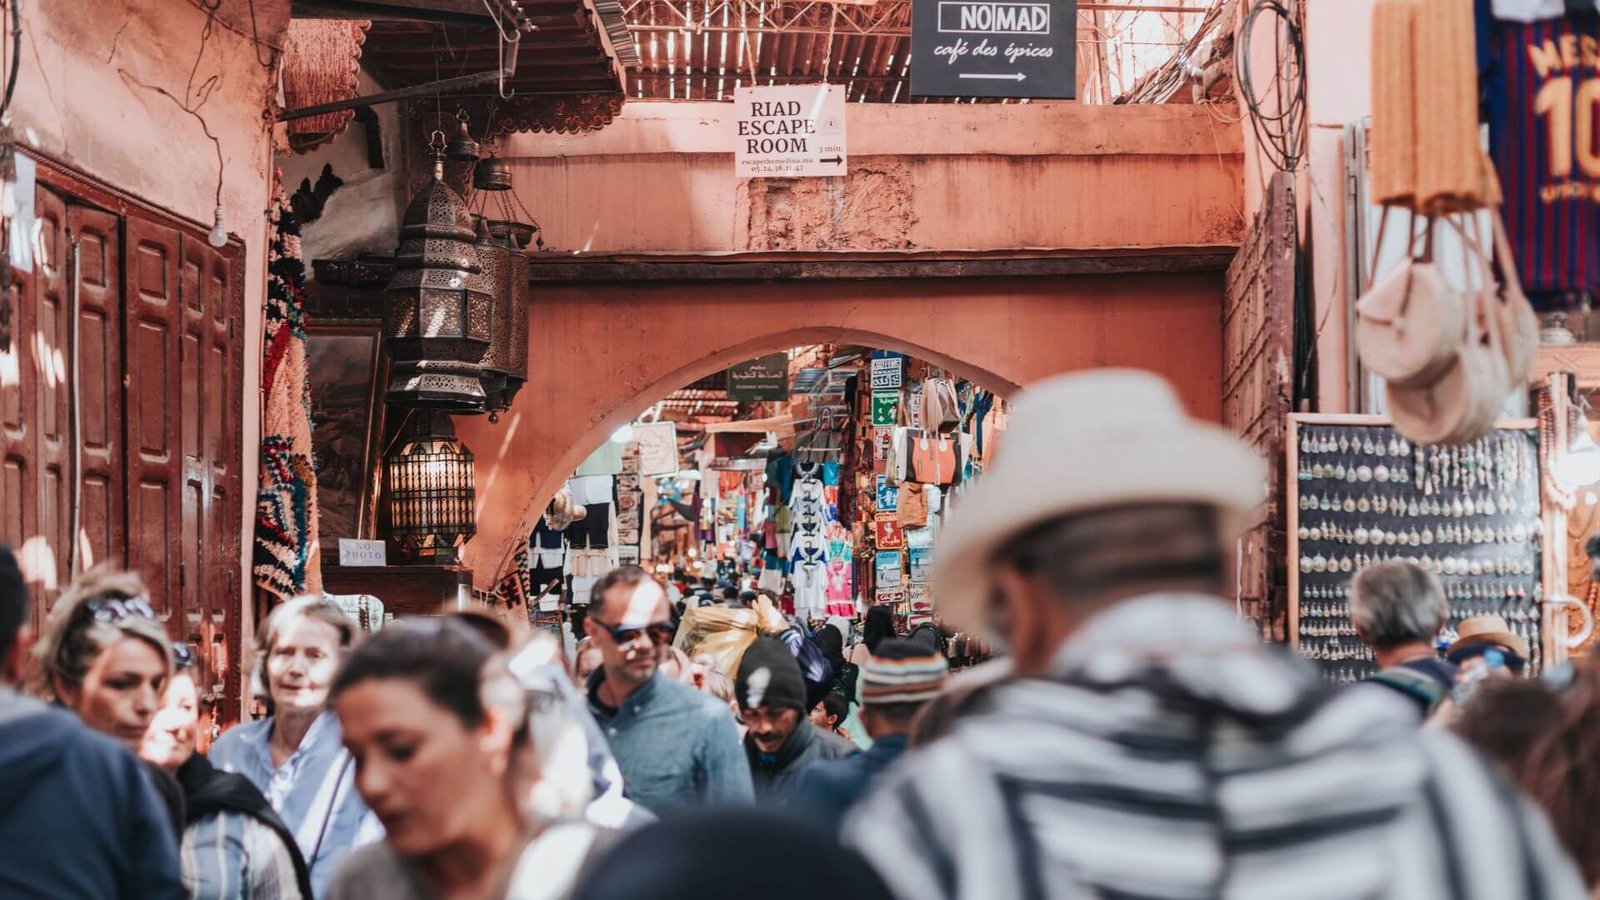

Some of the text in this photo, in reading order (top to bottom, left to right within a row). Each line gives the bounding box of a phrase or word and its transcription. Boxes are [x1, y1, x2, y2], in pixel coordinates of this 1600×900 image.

[934, 38, 1053, 64] café des épices
[1528, 33, 1600, 77] MES
[751, 101, 801, 117] RIAD
[738, 119, 816, 135] ESCAPE
[1534, 75, 1600, 177] 10
[746, 138, 808, 154] ROOM
[356, 542, 371, 551] NO
[346, 550, 382, 560] PHOTO
